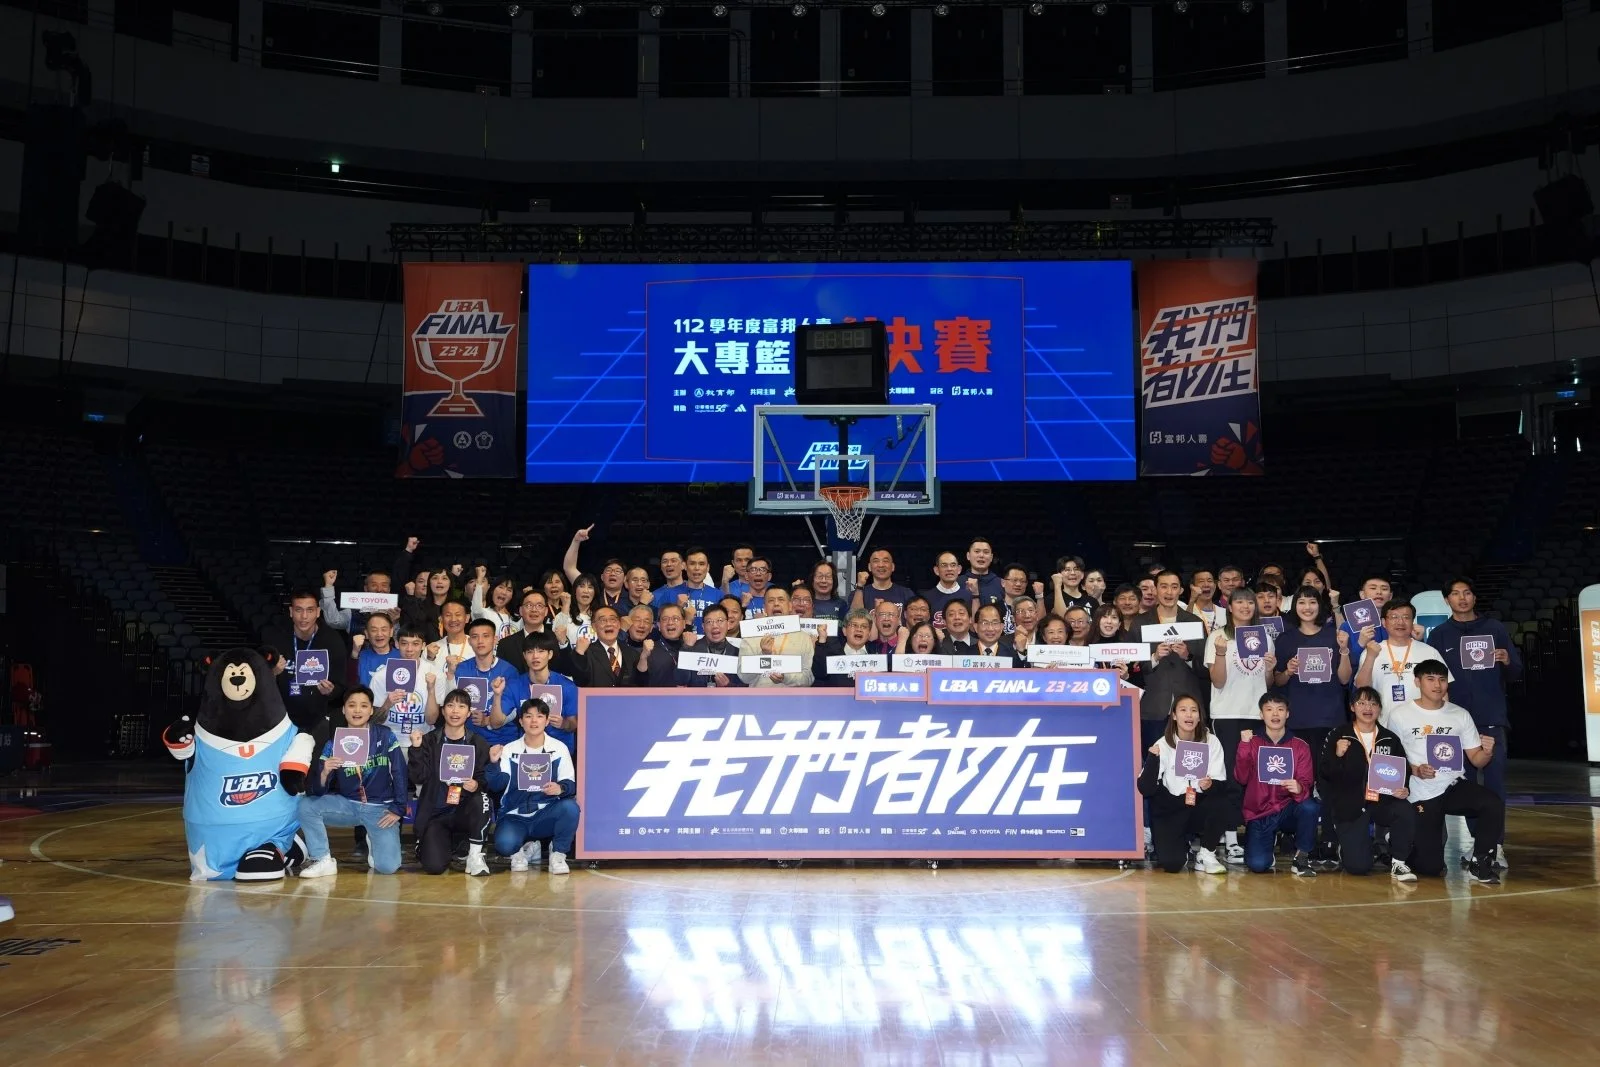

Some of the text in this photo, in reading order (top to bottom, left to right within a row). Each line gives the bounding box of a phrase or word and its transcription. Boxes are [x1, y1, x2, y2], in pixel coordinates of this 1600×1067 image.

[444, 301, 484, 313] UBA
[416, 314, 511, 335] FINAL
[673, 319, 704, 334] 112
[962, 388, 993, 396] 富邦人壽
[1164, 434, 1208, 444] 富邦人壽
[360, 597, 389, 605] TOYOTA
[756, 622, 785, 632] SPALDING
[1590, 620, 1600, 647] UBA
[697, 656, 720, 668] FIN
[850, 660, 878, 668] 教育部
[877, 682, 920, 693] 富邦人壽
[939, 679, 979, 693] UBA
[984, 679, 1041, 694] FINAL
[238, 744, 255, 758] U
[224, 773, 272, 794] UBA
